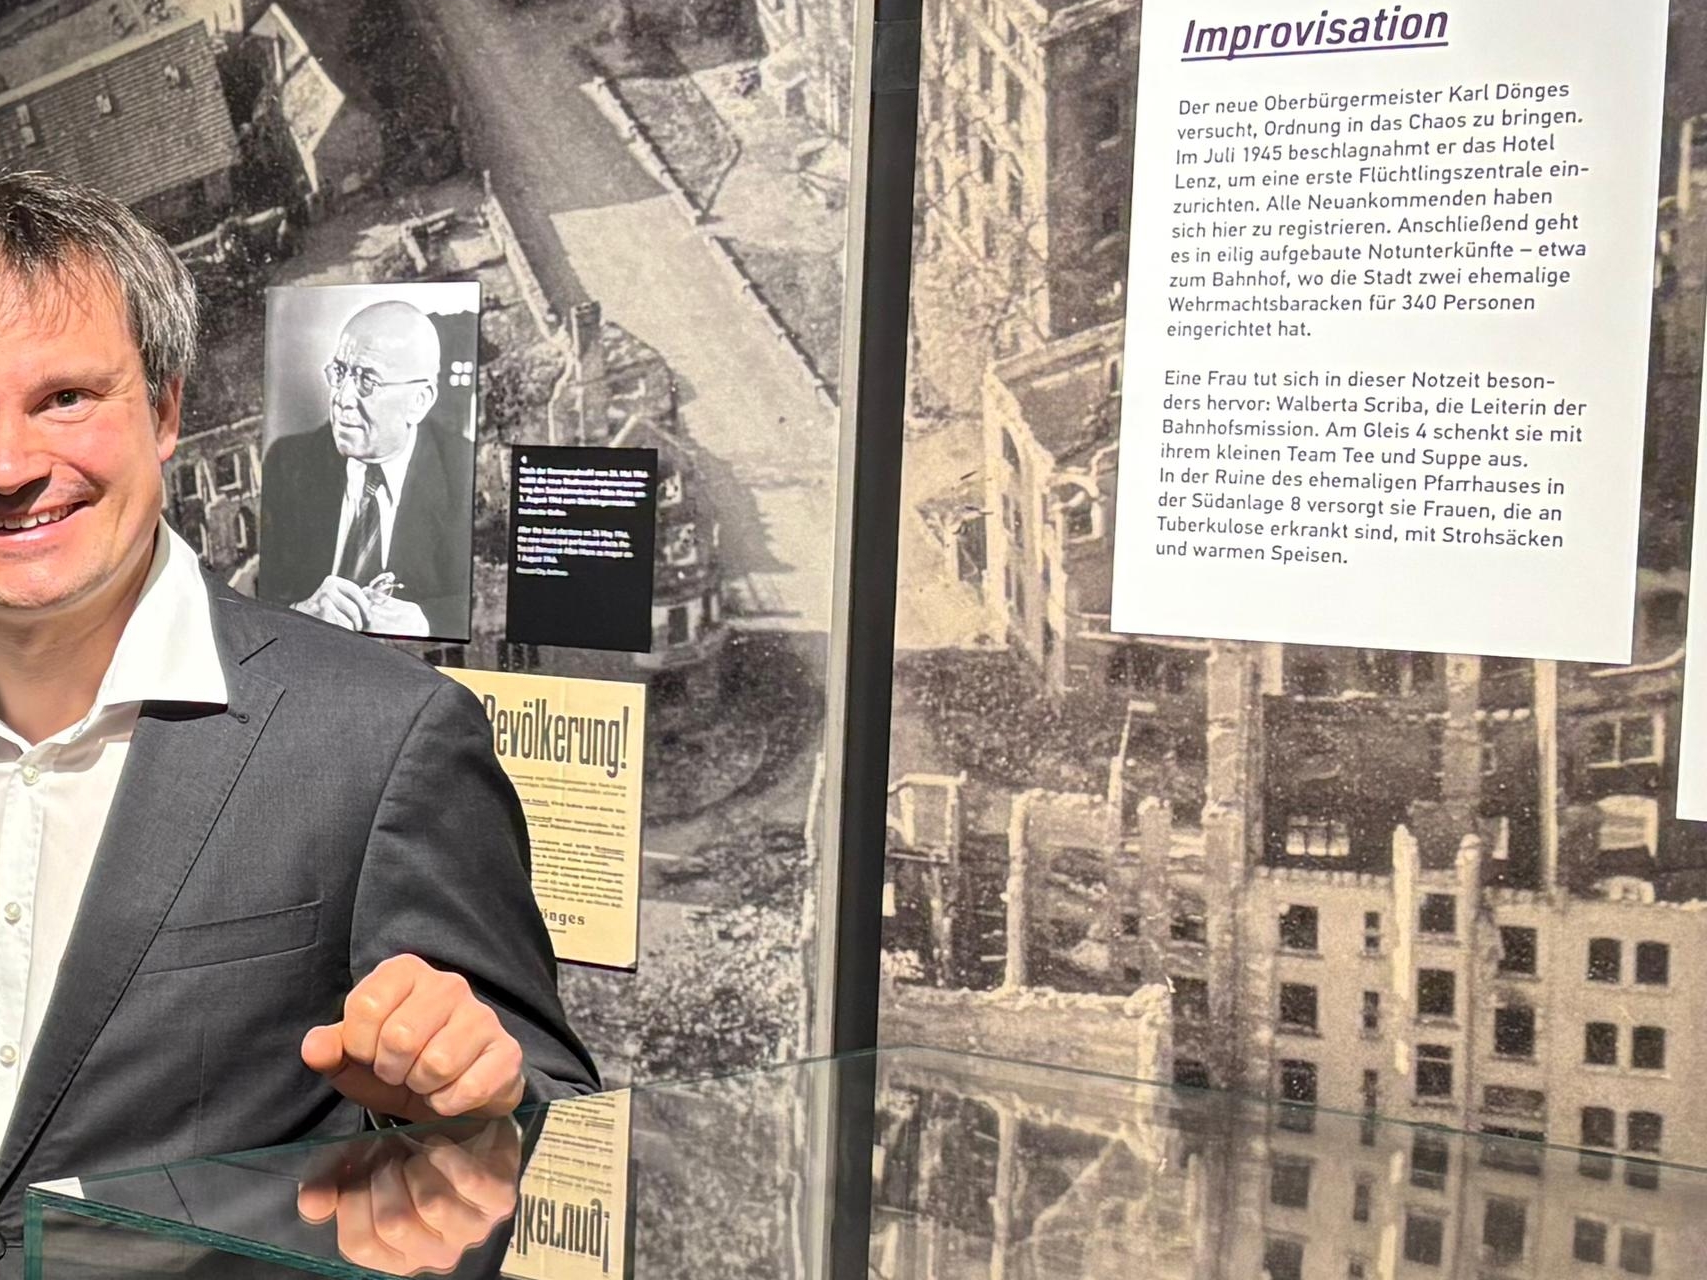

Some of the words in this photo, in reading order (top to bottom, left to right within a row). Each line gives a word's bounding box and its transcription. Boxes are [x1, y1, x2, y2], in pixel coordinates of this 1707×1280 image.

[1183, 5, 1449, 62] Improvisation
[1179, 100, 1211, 116] Der
[1215, 100, 1259, 114] neue
[1264, 88, 1444, 113] Oberbürgermeister
[1449, 83, 1489, 103] Karl
[1495, 82, 1570, 103] Dönges
[1177, 121, 1258, 140] versucht,
[1264, 118, 1341, 138] Ordnung
[1347, 116, 1364, 133] in
[1370, 114, 1403, 132] das
[1409, 112, 1467, 130] Chaos
[1472, 114, 1495, 128] zu
[1501, 108, 1583, 129] bringen.
[1176, 149, 1198, 166] Im
[1203, 146, 1235, 164] Juli
[1243, 144, 1283, 163] 1945
[1288, 139, 1431, 162] beschlagnahmt
[1436, 142, 1458, 155] er
[1462, 136, 1496, 155] das
[1502, 133, 1555, 153] Hotel
[1175, 173, 1221, 191] Lenz,
[1228, 175, 1256, 188] um
[1262, 170, 1300, 187] eine
[1306, 169, 1353, 185] erste
[1359, 160, 1543, 185] Flüchtlingszentrale
[1549, 160, 1590, 178] ein-
[1173, 196, 1260, 215] zurichten.
[1266, 194, 1302, 212] Alle
[1308, 189, 1487, 211] Neuankommenden
[1493, 187, 1553, 206] haben
[1172, 221, 1207, 239] sich
[1212, 221, 1248, 238] hier
[1252, 224, 1272, 237] zu
[1278, 218, 1392, 240] registrieren.
[1397, 213, 1529, 234] Anschließend
[1535, 212, 1579, 236] geht
[1170, 251, 1191, 264] es
[1195, 247, 1211, 263] in
[1217, 246, 1254, 266] eilig
[1259, 243, 1362, 265] aufgebaute
[1368, 240, 1514, 260] Notunterkünfte
[1538, 242, 1587, 258] etwa
[1169, 275, 1206, 288] zum
[1212, 269, 1291, 289] Bahnhof,
[1297, 274, 1324, 287] wo
[1330, 269, 1358, 286] die
[1363, 268, 1412, 286] Stadt
[1418, 267, 1462, 285] zwei
[1467, 266, 1571, 288] ehemalige
[1168, 294, 1363, 312] Wehrmachtsbaracken
[1369, 294, 1397, 312] für
[1402, 294, 1437, 311] 340
[1443, 294, 1535, 311] Personen
[1166, 320, 1272, 341] eingerichtet
[1278, 319, 1312, 337] hat.
[1164, 370, 1202, 386] Eine
[1207, 370, 1247, 387] Frau
[1253, 372, 1278, 387] tut
[1283, 370, 1319, 387] sich
[1325, 370, 1342, 388] in
[1348, 370, 1406, 388] dieser
[1412, 371, 1480, 389] Notzeit
[1487, 371, 1556, 390] beson-
[1163, 393, 1201, 411] ders
[1207, 394, 1271, 412] hervor:
[1276, 395, 1358, 413] Walberta
[1363, 396, 1429, 416] Scriba,
[1436, 397, 1464, 415] die
[1471, 397, 1547, 416] Leiterin
[1553, 398, 1588, 417] der
[1162, 418, 1319, 438] Bahnhofsmission.
[1325, 421, 1357, 438] Am
[1363, 421, 1410, 439] Gleis
[1415, 422, 1427, 440] 4
[1433, 422, 1510, 441] schenkt
[1514, 424, 1544, 442] sie
[1550, 425, 1583, 443] mit
